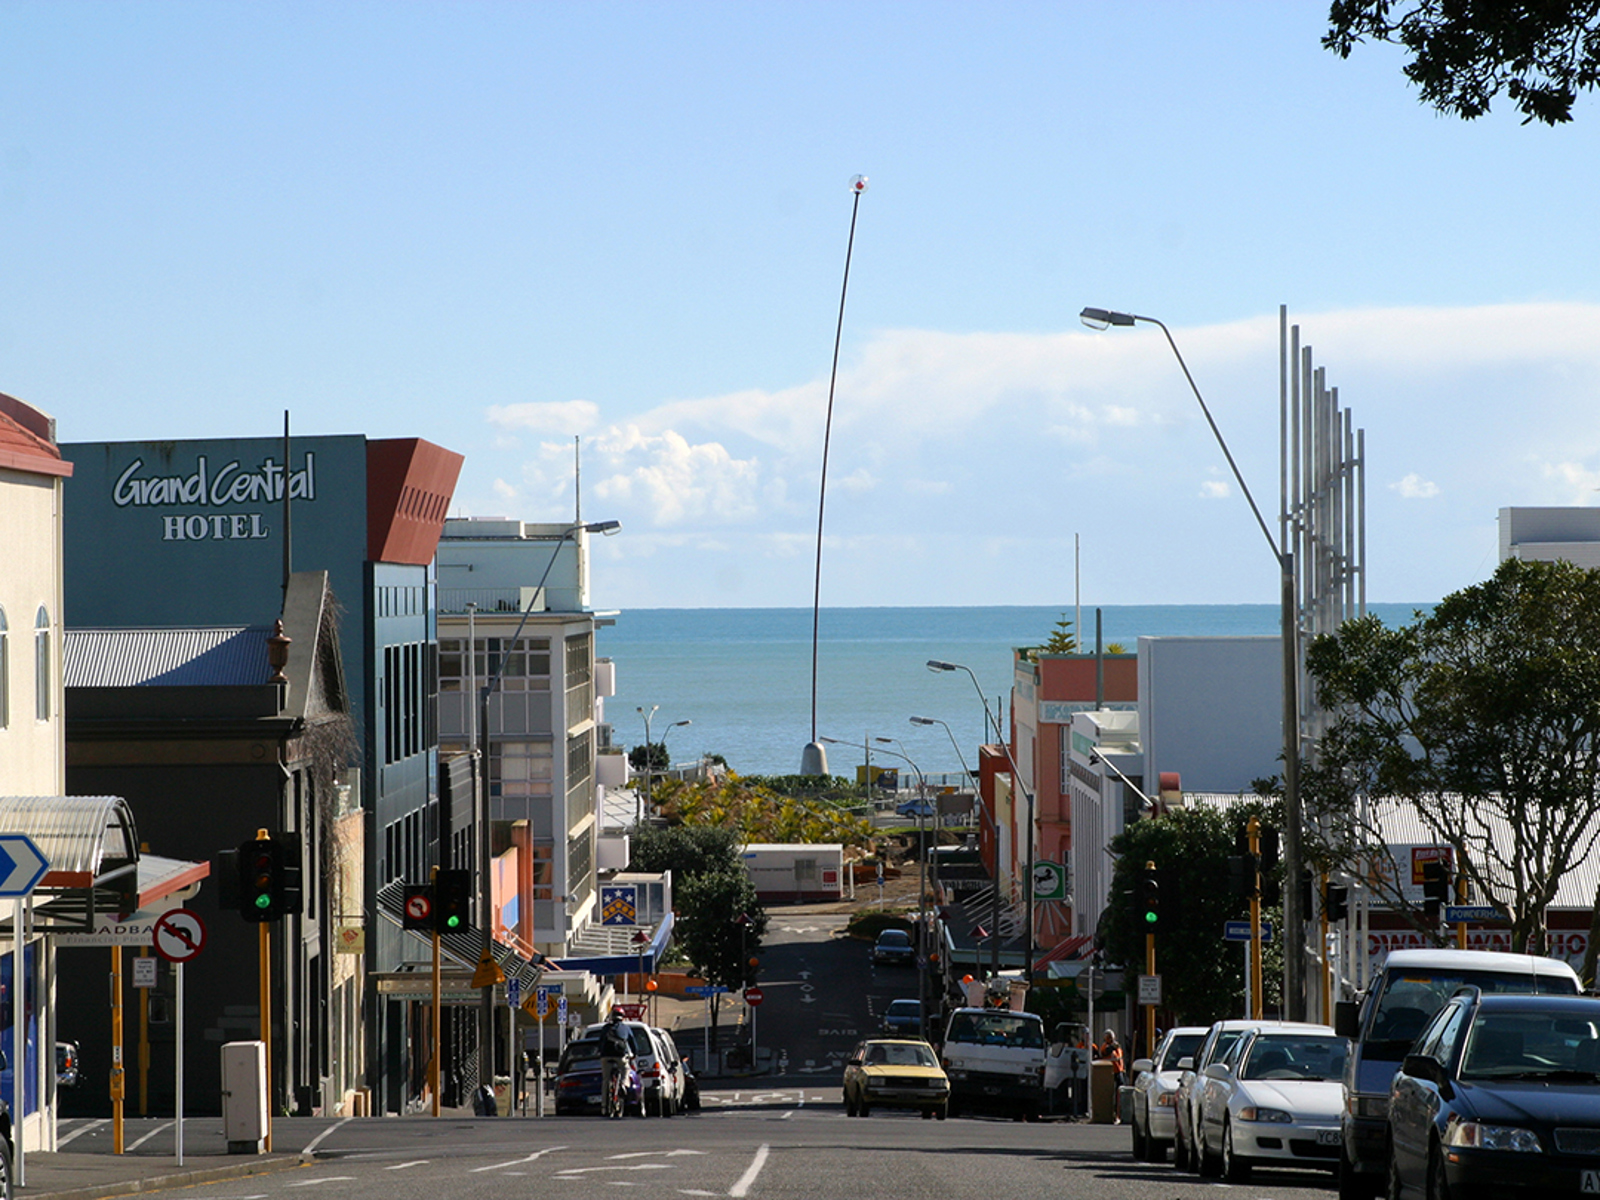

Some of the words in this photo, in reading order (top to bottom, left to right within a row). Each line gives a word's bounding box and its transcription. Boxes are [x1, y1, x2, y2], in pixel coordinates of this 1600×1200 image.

[113, 455, 208, 508] Grand
[209, 451, 316, 507] Central
[162, 513, 269, 542] HOTEL
[57, 925, 154, 935] ADBA
[67, 936, 118, 944] Financial
[1346, 934, 1511, 955] OWNWN
[1318, 1132, 1342, 1144] YC8
